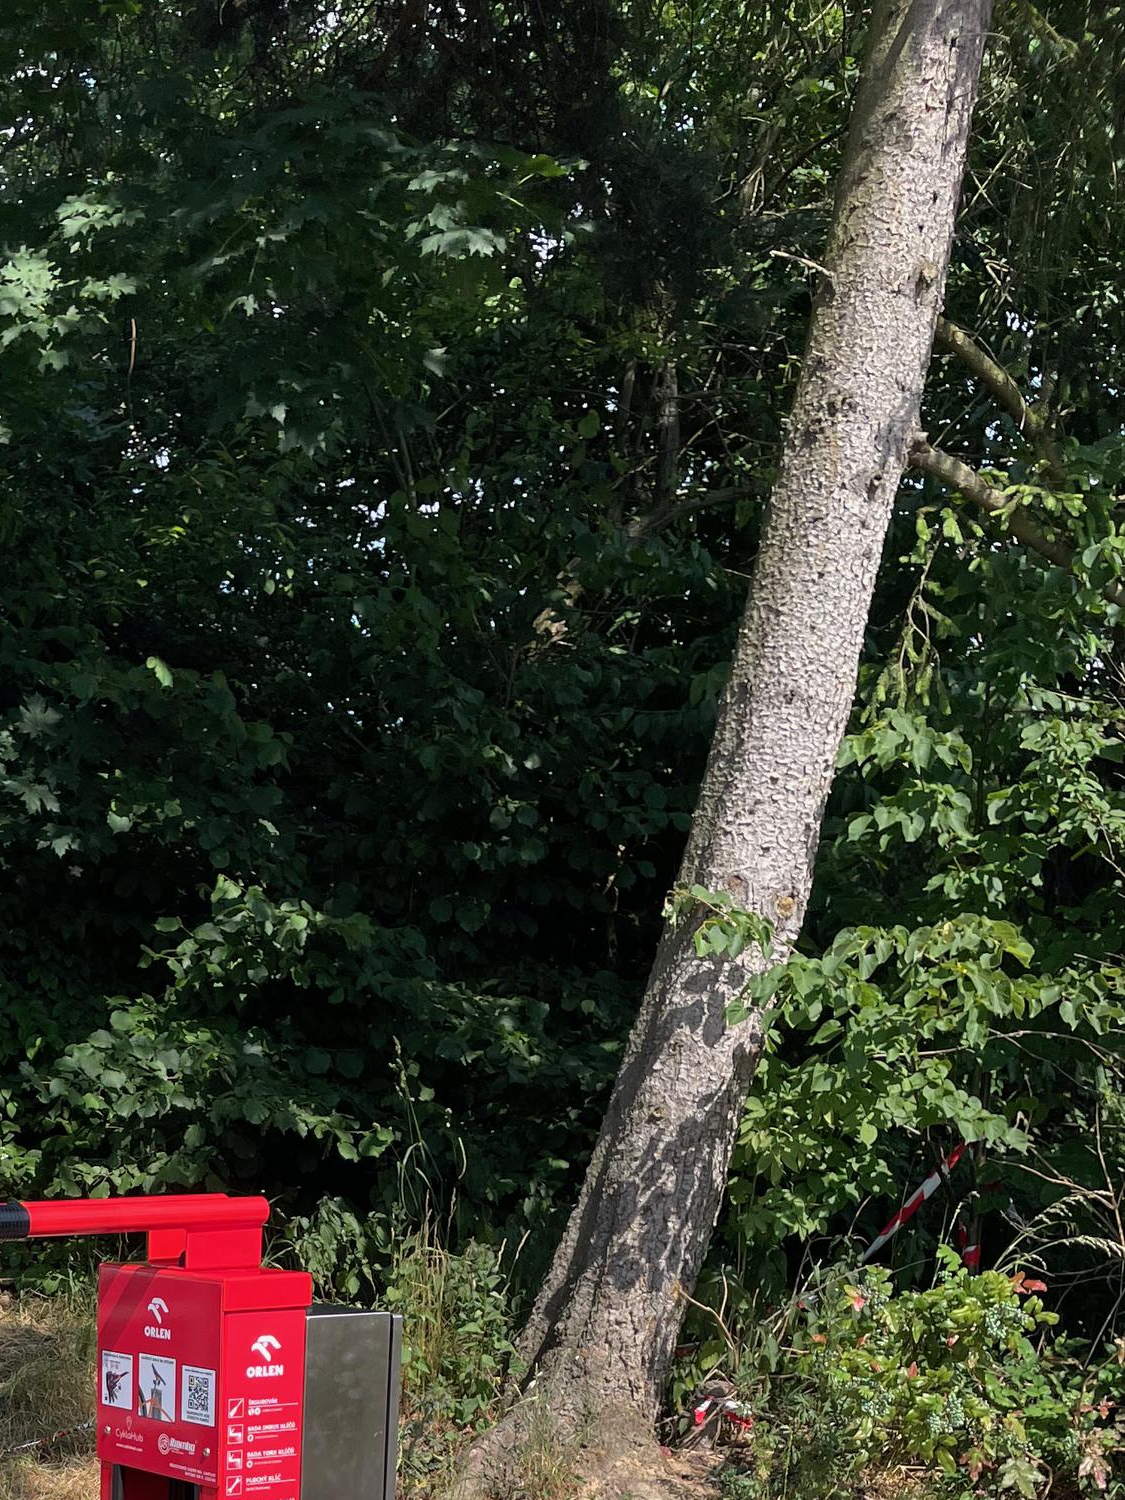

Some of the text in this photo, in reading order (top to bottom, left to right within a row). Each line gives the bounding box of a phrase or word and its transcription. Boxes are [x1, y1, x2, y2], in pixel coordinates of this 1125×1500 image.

[144, 1325, 171, 1340] ORLEN
[246, 1364, 284, 1378] ORLEN
[246, 1473, 281, 1483] PLOCHÝ KLÍČ
